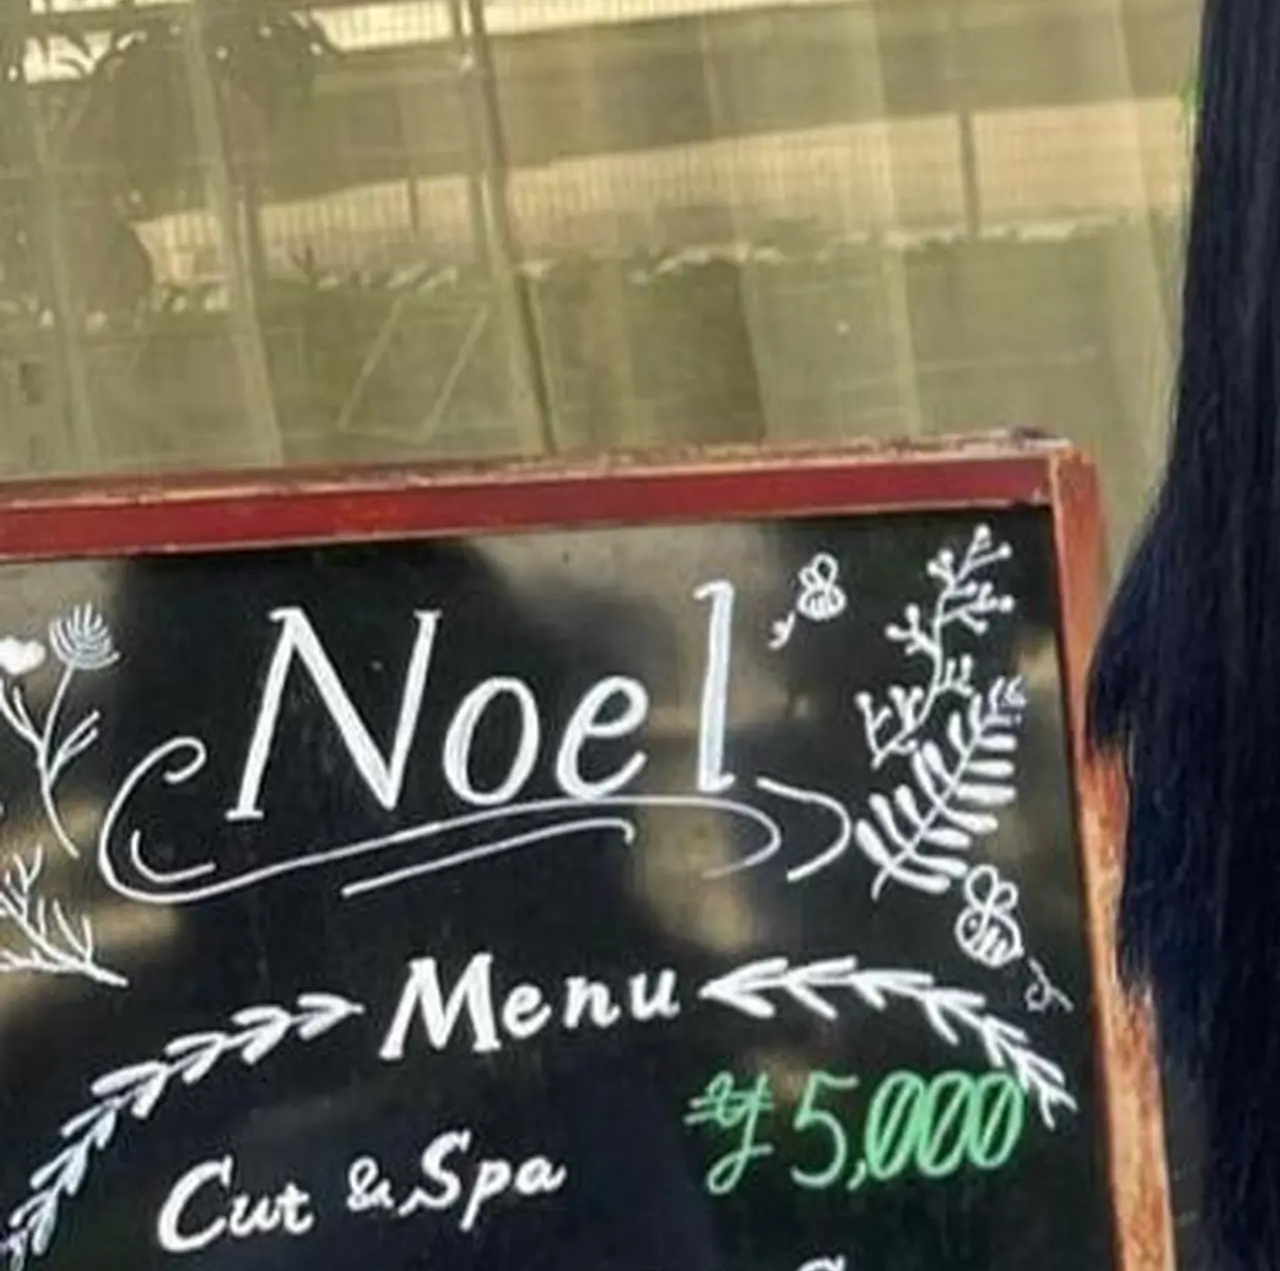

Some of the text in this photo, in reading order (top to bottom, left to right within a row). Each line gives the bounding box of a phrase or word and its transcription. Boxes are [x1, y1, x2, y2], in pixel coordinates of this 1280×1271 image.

[226, 580, 735, 820] Noel
[380, 954, 680, 1059] Menu
[157, 1155, 315, 1252] Cut
